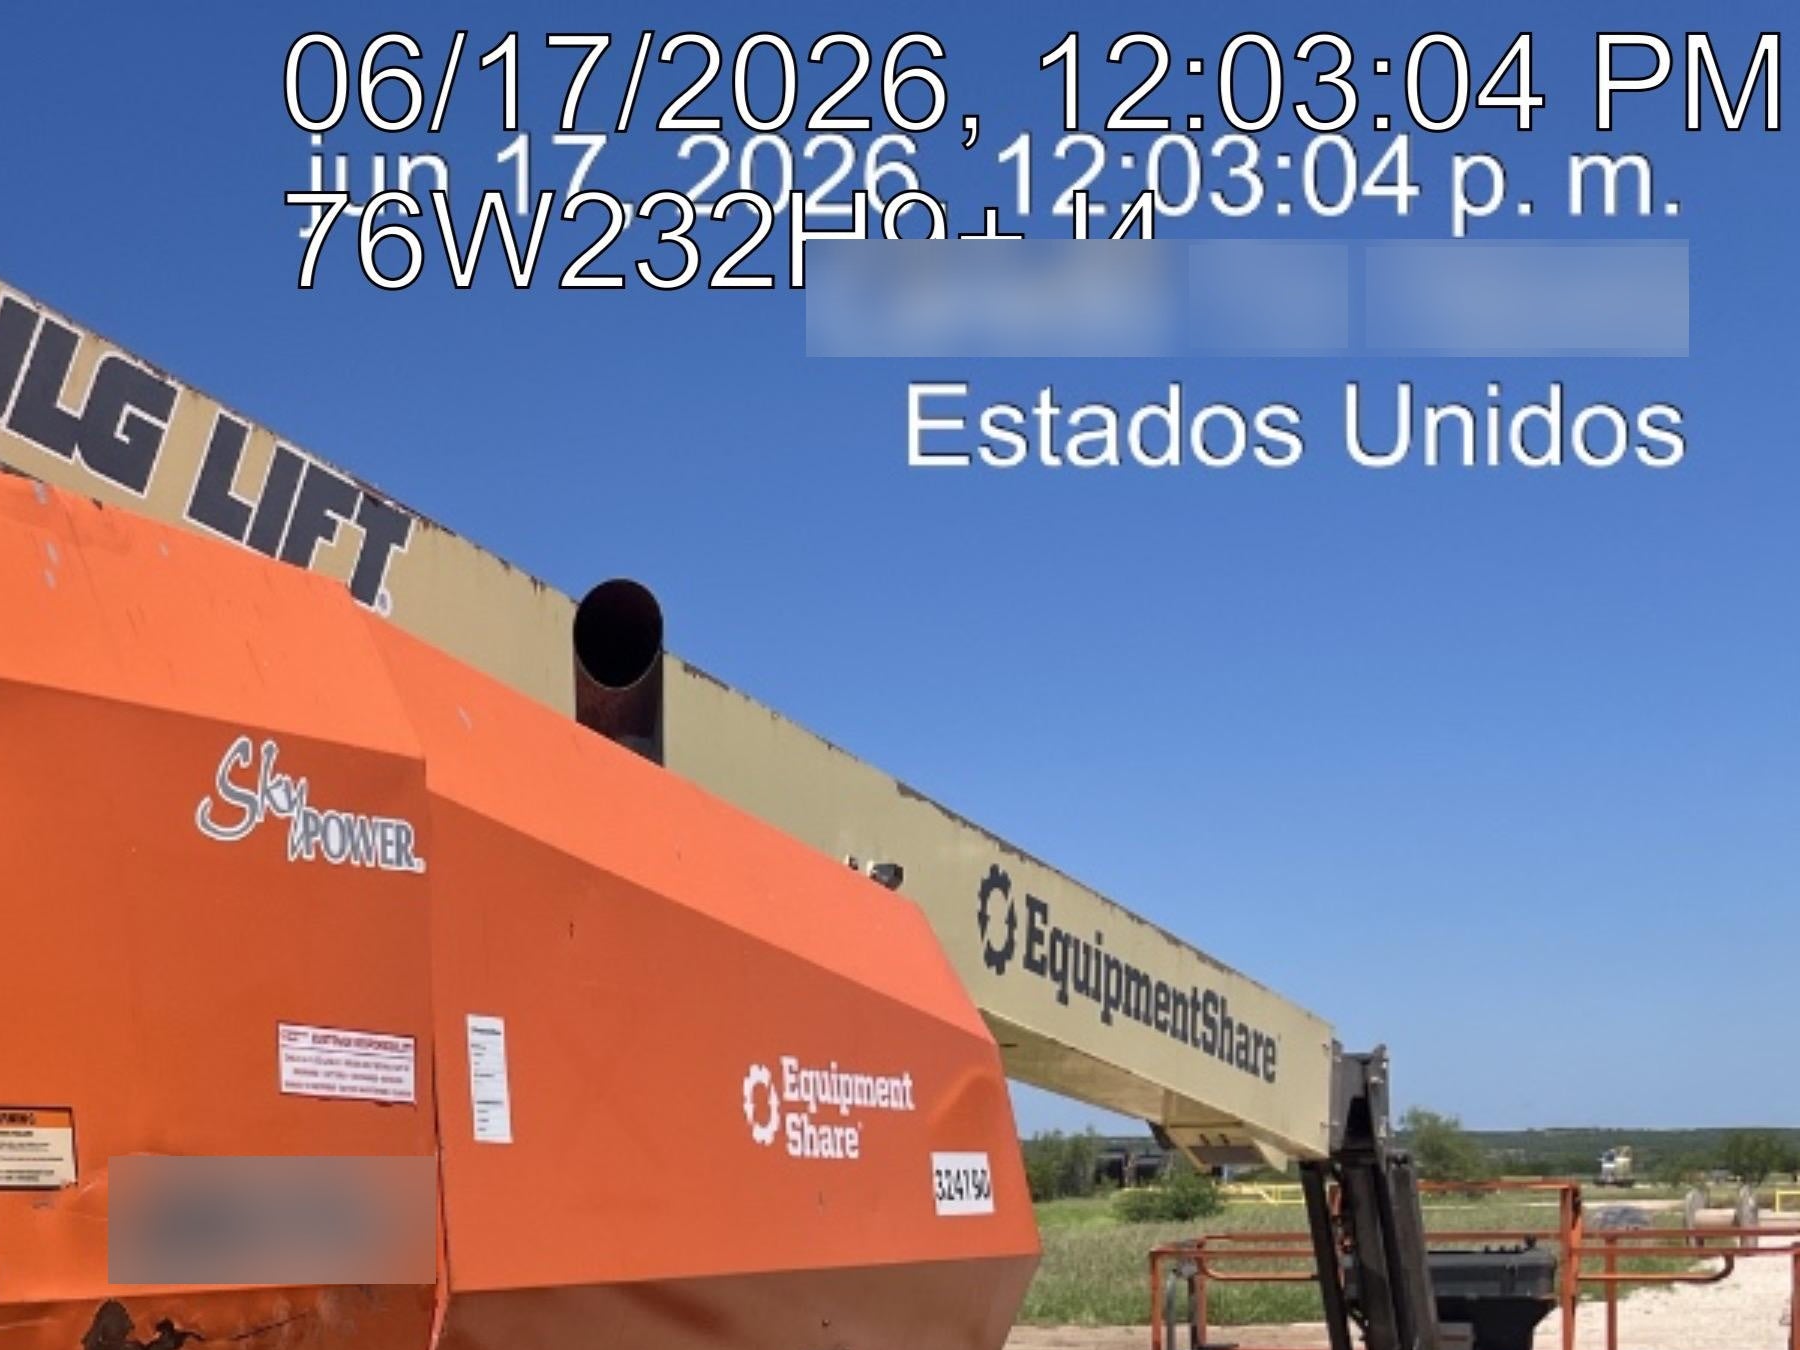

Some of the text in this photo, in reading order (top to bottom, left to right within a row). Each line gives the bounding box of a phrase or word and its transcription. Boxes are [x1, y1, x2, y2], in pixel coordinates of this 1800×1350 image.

[184, 407, 419, 613] LIFT
[196, 736, 309, 861] Sky
[1022, 893, 1277, 1084] EquipmentShare
[780, 1055, 915, 1117] Equipment
[785, 1113, 859, 1159] Share
[934, 1168, 991, 1201] 324190
